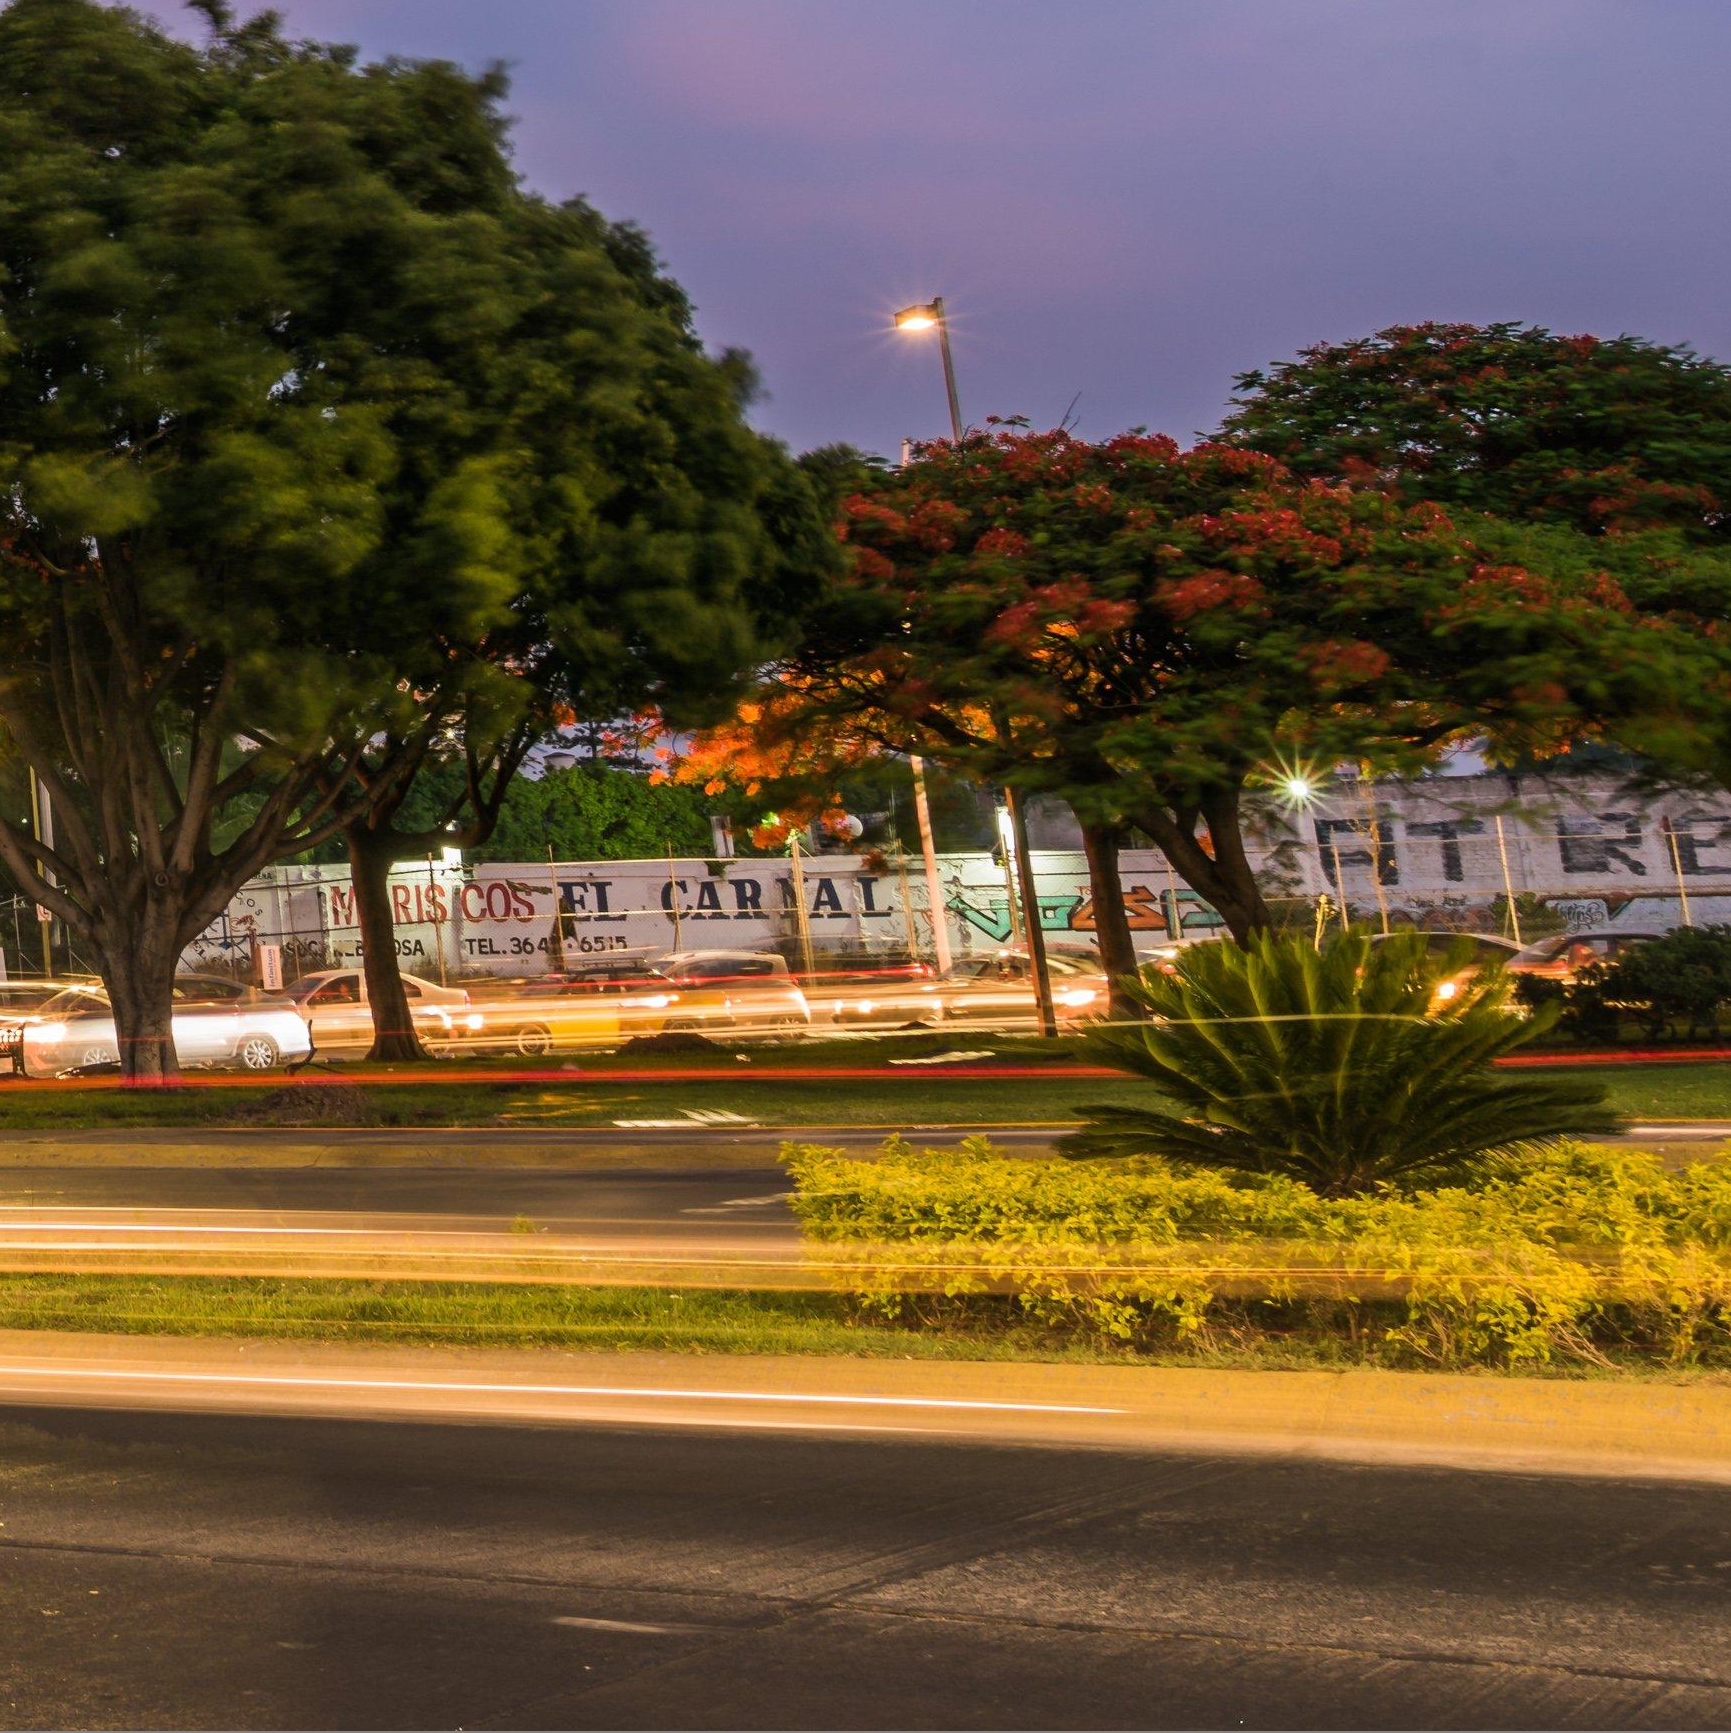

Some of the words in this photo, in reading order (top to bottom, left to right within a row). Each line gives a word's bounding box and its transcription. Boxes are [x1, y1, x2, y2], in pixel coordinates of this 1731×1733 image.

[330, 882, 536, 926] MRISCOS
[556, 881, 628, 923] EL
[660, 876, 894, 921] CARNAL
